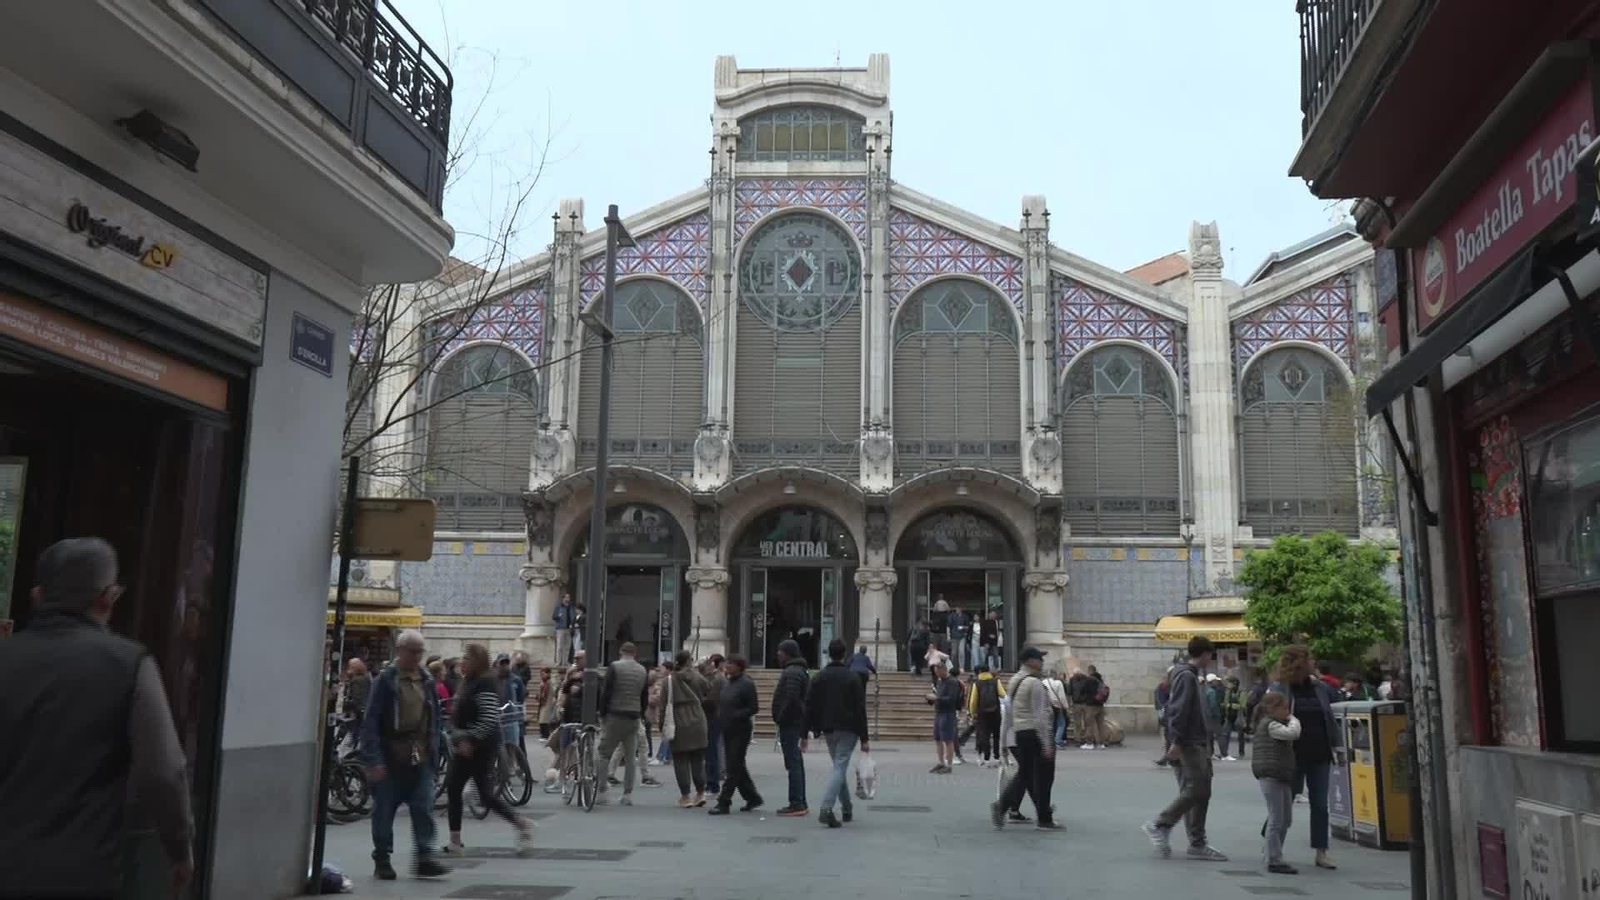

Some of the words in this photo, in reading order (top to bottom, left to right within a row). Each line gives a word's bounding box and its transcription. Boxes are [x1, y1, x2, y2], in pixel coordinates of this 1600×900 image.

[1454, 180, 1524, 274] Boatella
[1526, 119, 1592, 204] Tapas
[775, 540, 831, 558] CENTRAL
